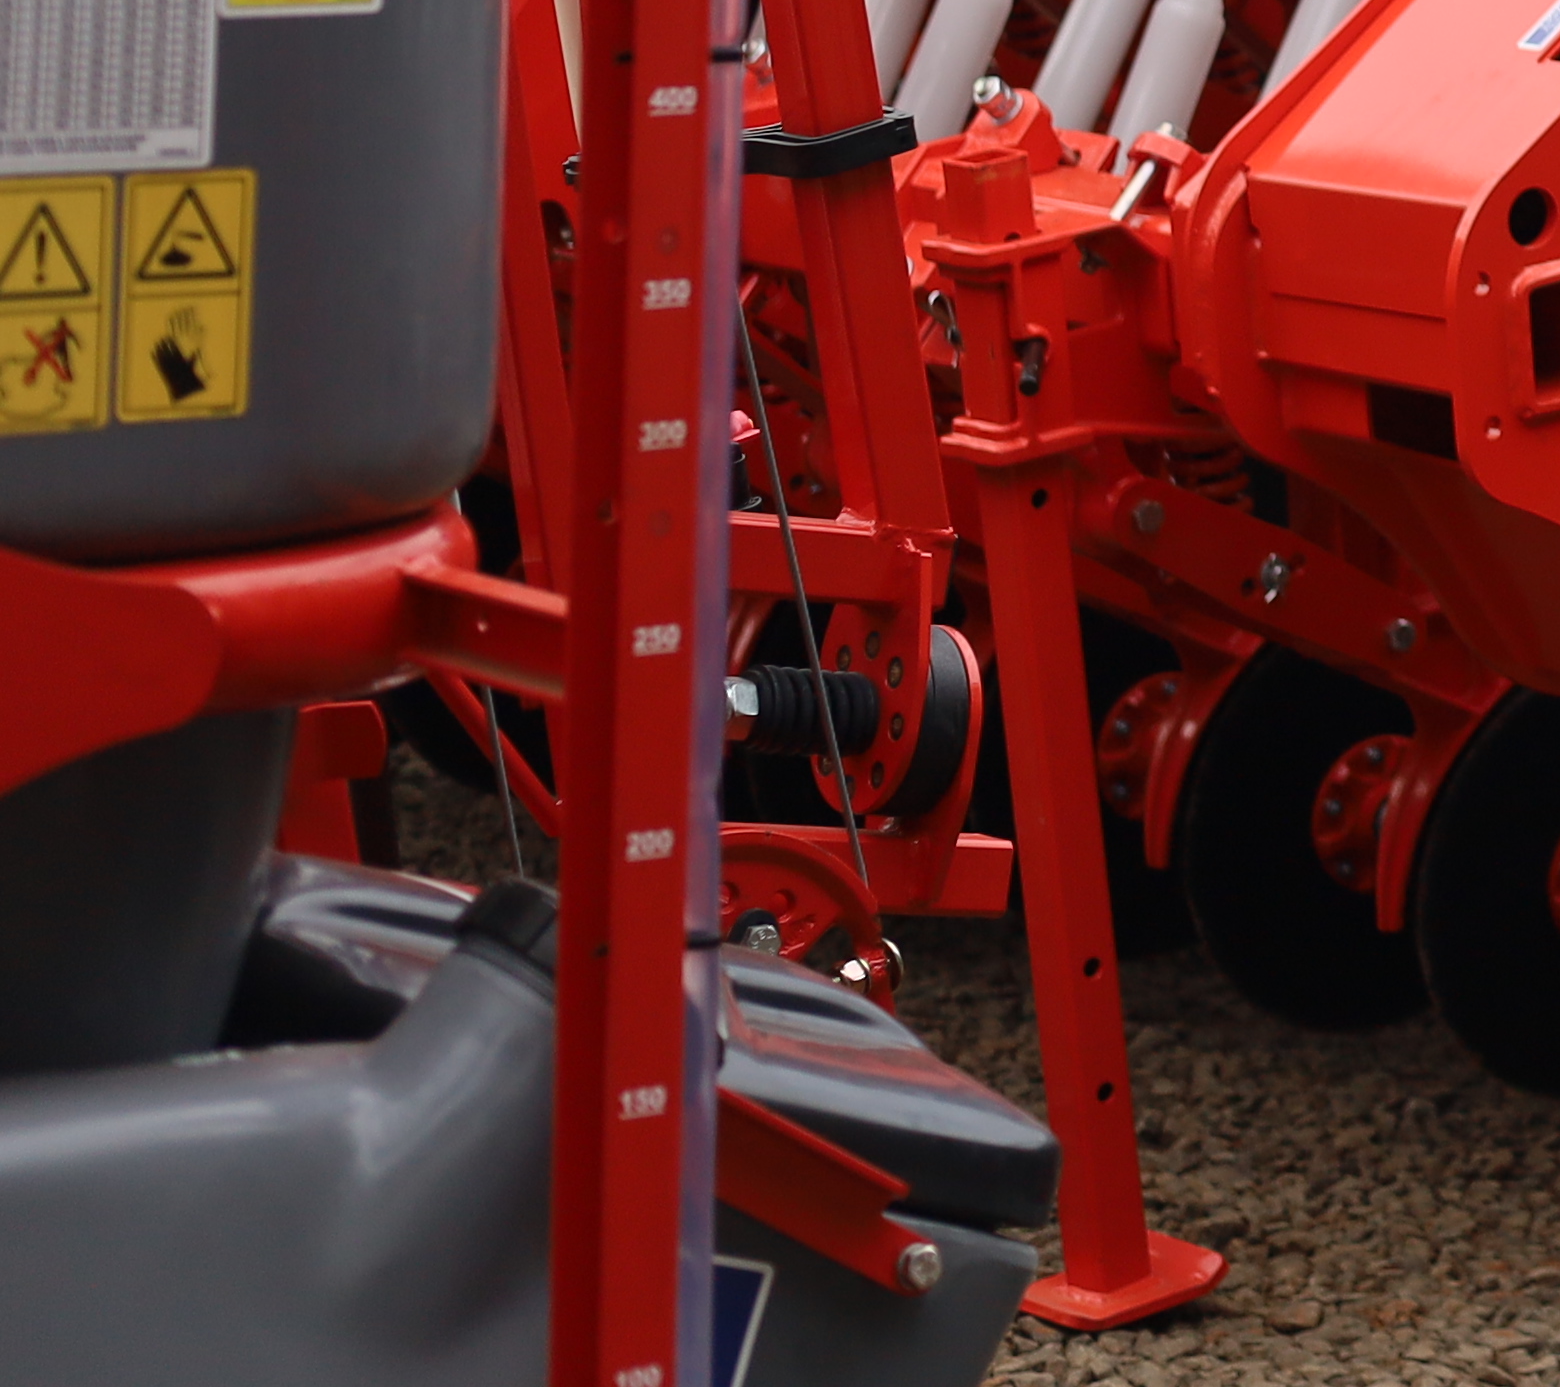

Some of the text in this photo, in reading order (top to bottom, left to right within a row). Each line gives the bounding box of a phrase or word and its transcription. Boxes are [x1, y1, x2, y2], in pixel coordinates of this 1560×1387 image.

[648, 85, 698, 112] 400
[643, 278, 692, 307] 350
[638, 419, 687, 448] 300
[633, 624, 681, 653] 250
[626, 829, 674, 858] 200
[620, 1085, 667, 1115] 150
